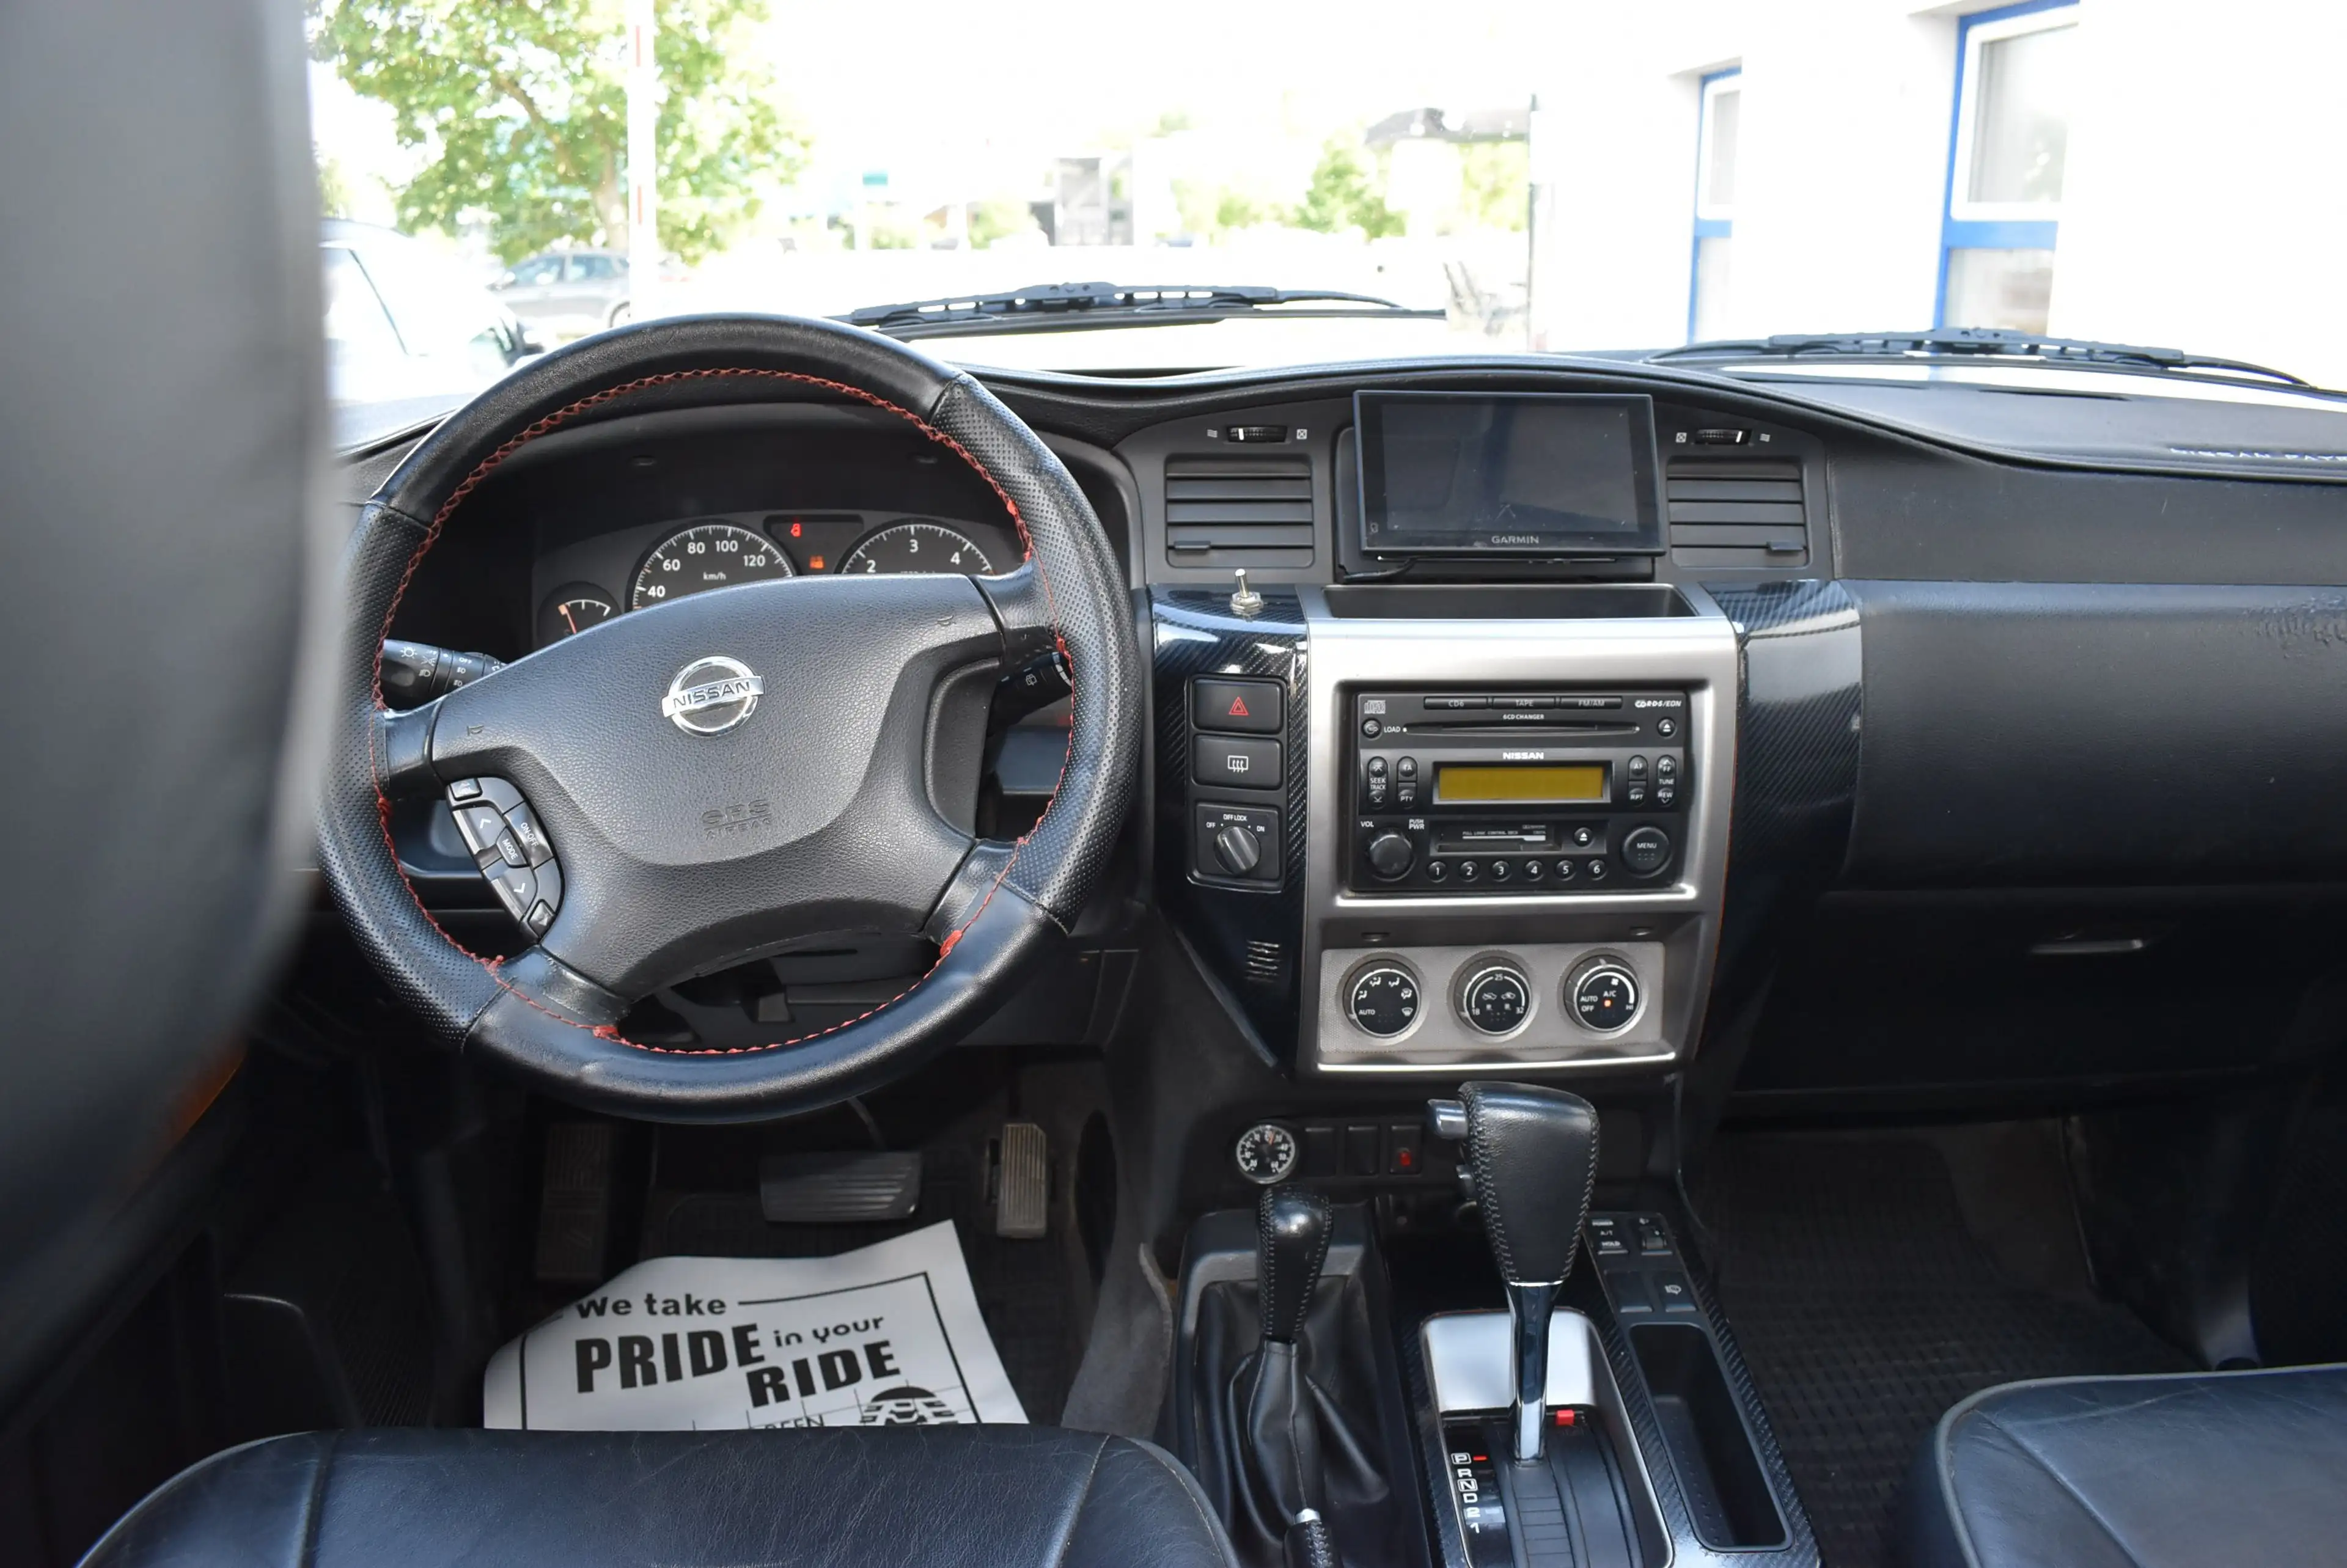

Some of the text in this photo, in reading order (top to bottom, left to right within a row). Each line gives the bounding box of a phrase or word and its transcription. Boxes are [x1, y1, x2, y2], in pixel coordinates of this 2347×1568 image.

[909, 539, 919, 552] 3
[1491, 535, 1540, 544] GARMIN
[687, 542, 705, 554] 80
[715, 540, 738, 552] 100
[743, 554, 765, 567] 120
[950, 552, 961, 565] 4
[663, 559, 681, 571] 60
[867, 560, 876, 573] 2
[703, 571, 727, 581] km/h
[648, 585, 666, 598] 40
[673, 681, 751, 708] NISSAN
[502, 838, 518, 860] MODE
[1435, 867, 1440, 876] 1
[1466, 866, 1472, 876] 2
[1497, 866, 1504, 875] 3
[1563, 865, 1570, 874] 5
[1593, 865, 1600, 873] 6
[575, 1293, 727, 1318] We take
[575, 1316, 884, 1393] PRIDE in your
[746, 1340, 900, 1408] RIDE
[1457, 1468, 1472, 1478] R
[1463, 1492, 1478, 1503] D
[1466, 1507, 1481, 1518] 2
[1470, 1522, 1480, 1534] 1
